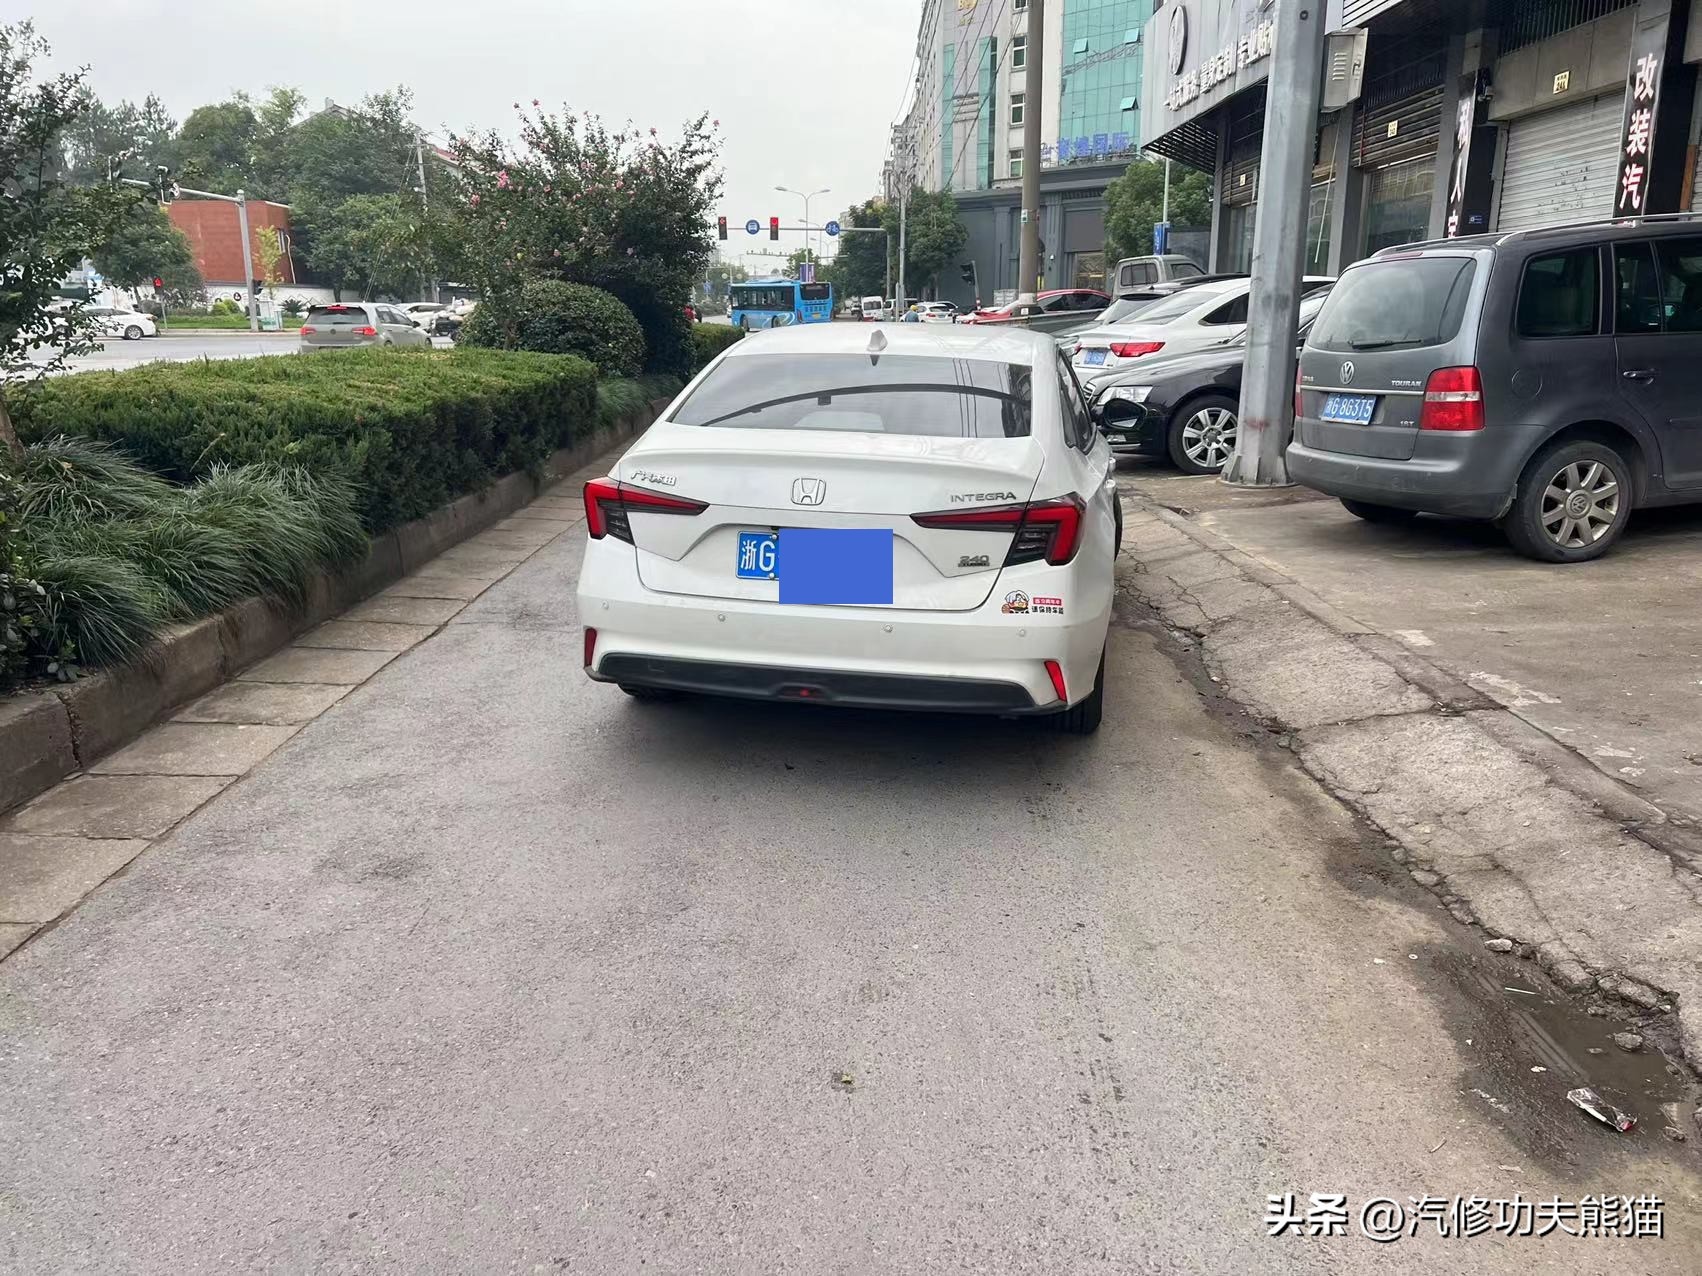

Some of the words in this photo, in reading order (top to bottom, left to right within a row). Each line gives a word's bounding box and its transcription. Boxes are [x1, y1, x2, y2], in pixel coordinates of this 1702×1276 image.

[1619, 53, 1658, 226] 改装汽
[630, 470, 677, 486] 广汽本田
[950, 492, 1017, 503] INTEGRA
[959, 554, 990, 564] 240
